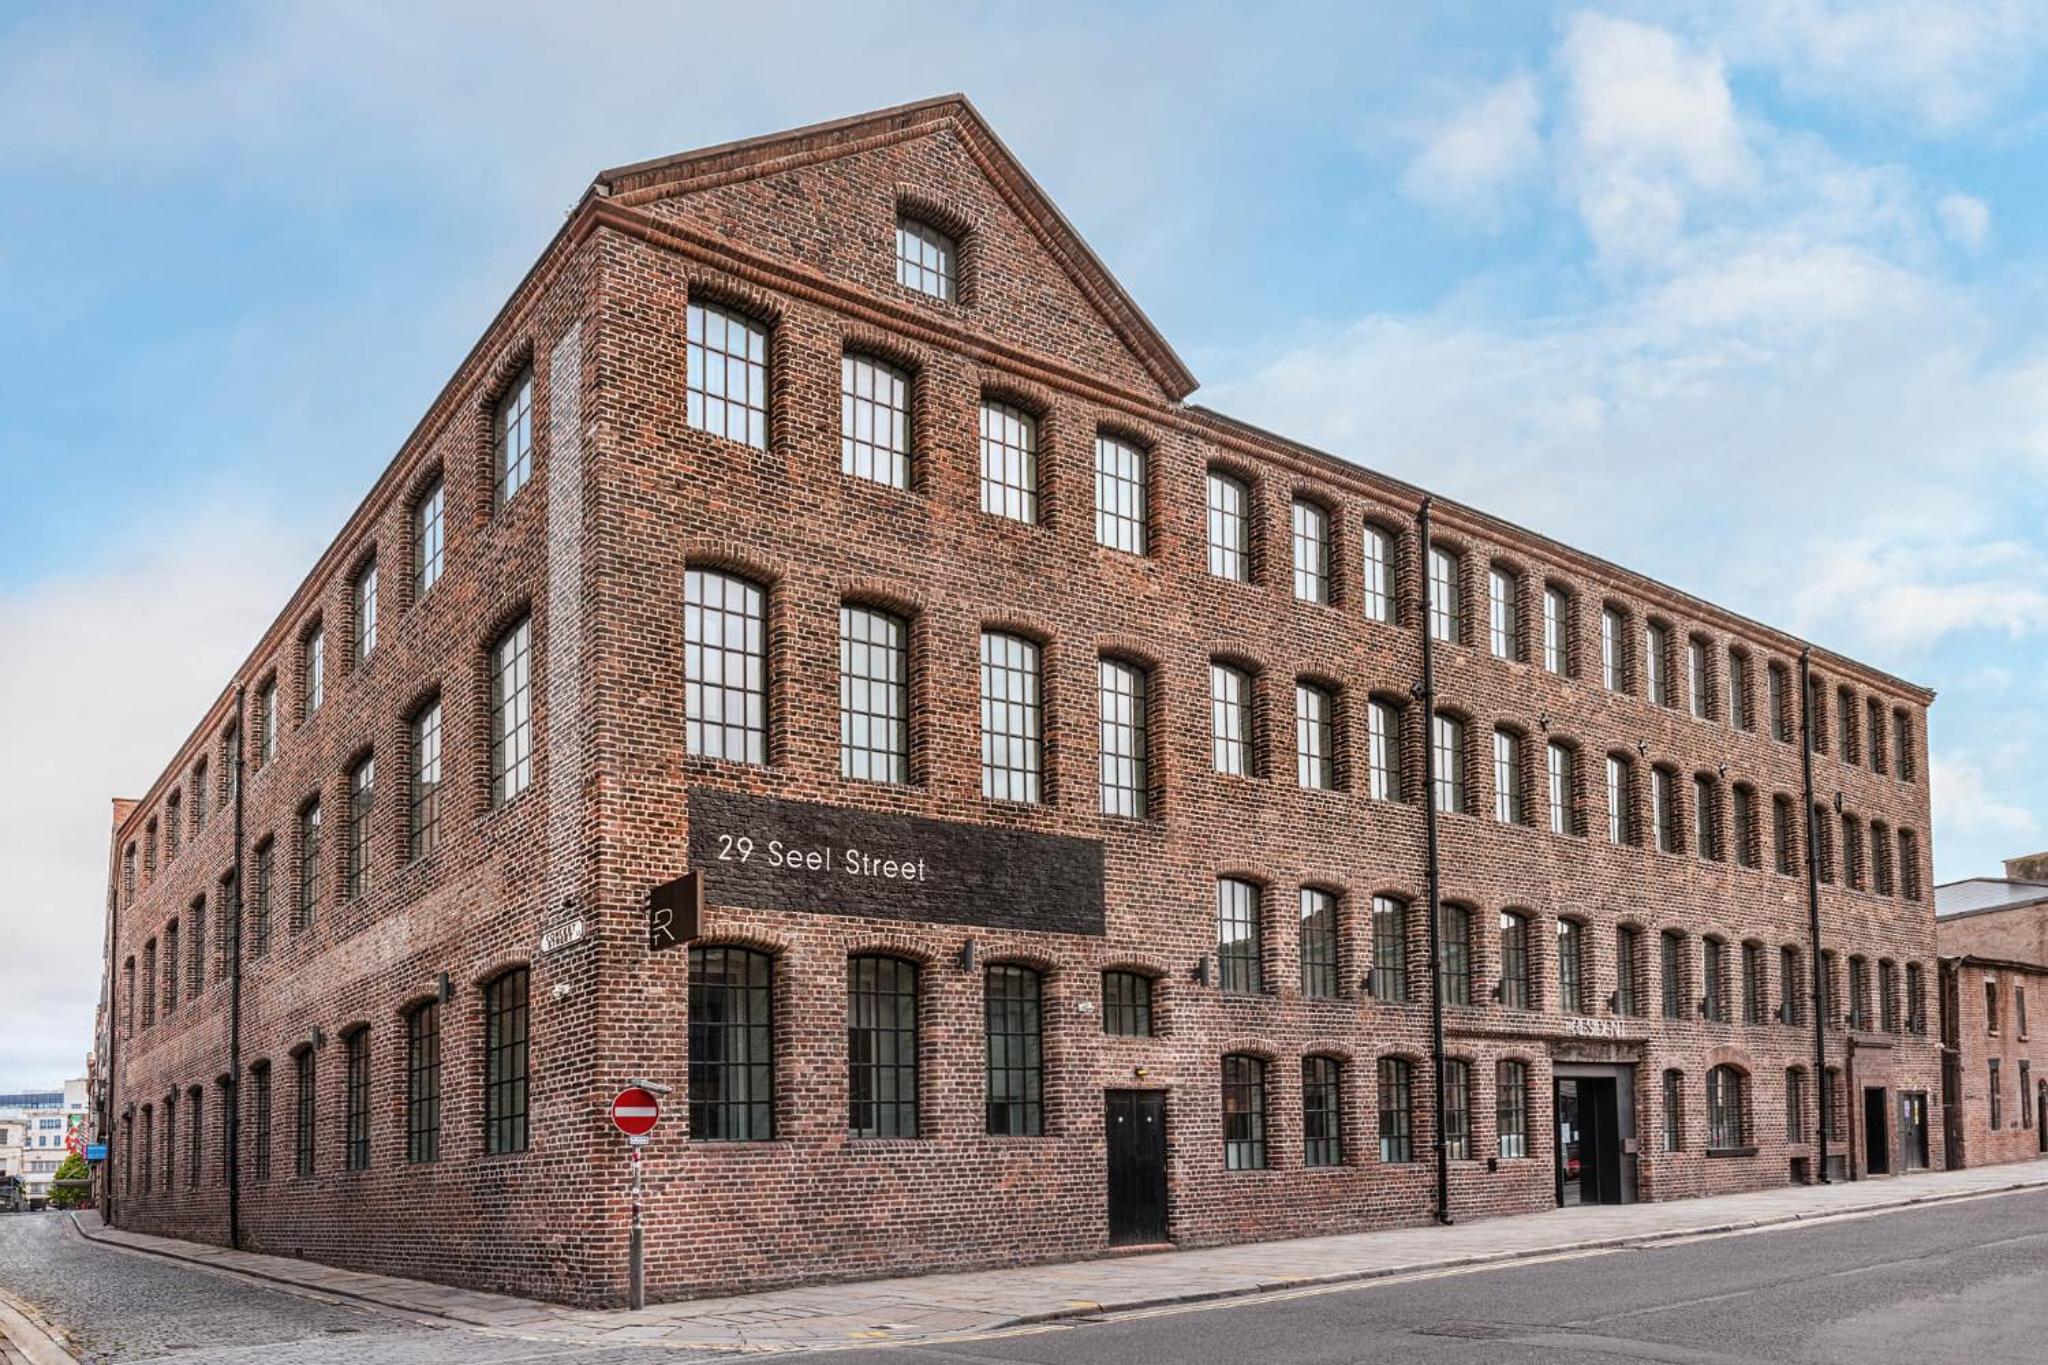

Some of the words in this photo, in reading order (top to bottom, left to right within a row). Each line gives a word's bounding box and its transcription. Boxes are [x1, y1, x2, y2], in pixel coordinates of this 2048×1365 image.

[718, 835, 753, 862] 29
[768, 840, 830, 871] Seel
[845, 849, 925, 881] Street
